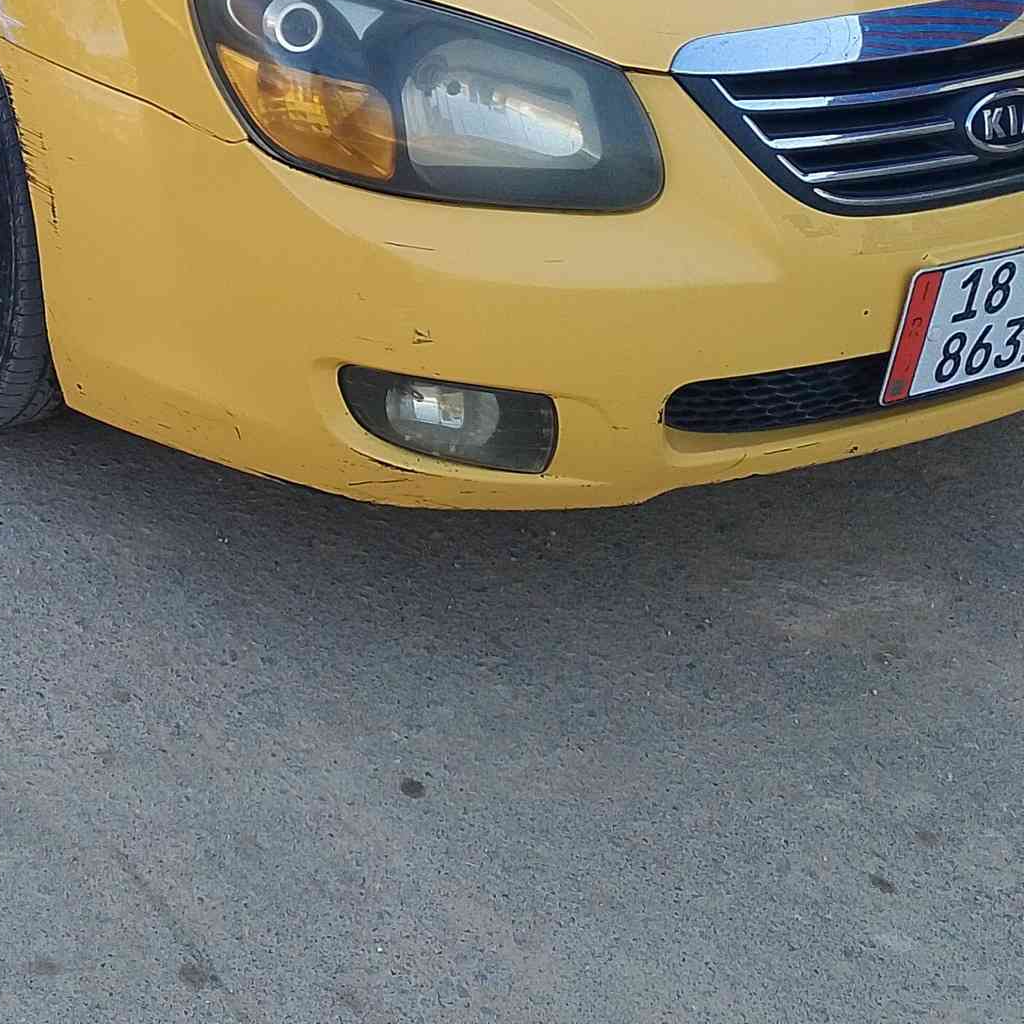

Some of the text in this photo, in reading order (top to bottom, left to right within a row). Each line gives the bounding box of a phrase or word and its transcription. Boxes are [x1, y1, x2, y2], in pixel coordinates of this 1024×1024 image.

[982, 104, 1024, 141] KI
[951, 261, 1017, 323] 18
[934, 316, 1024, 384] 863
